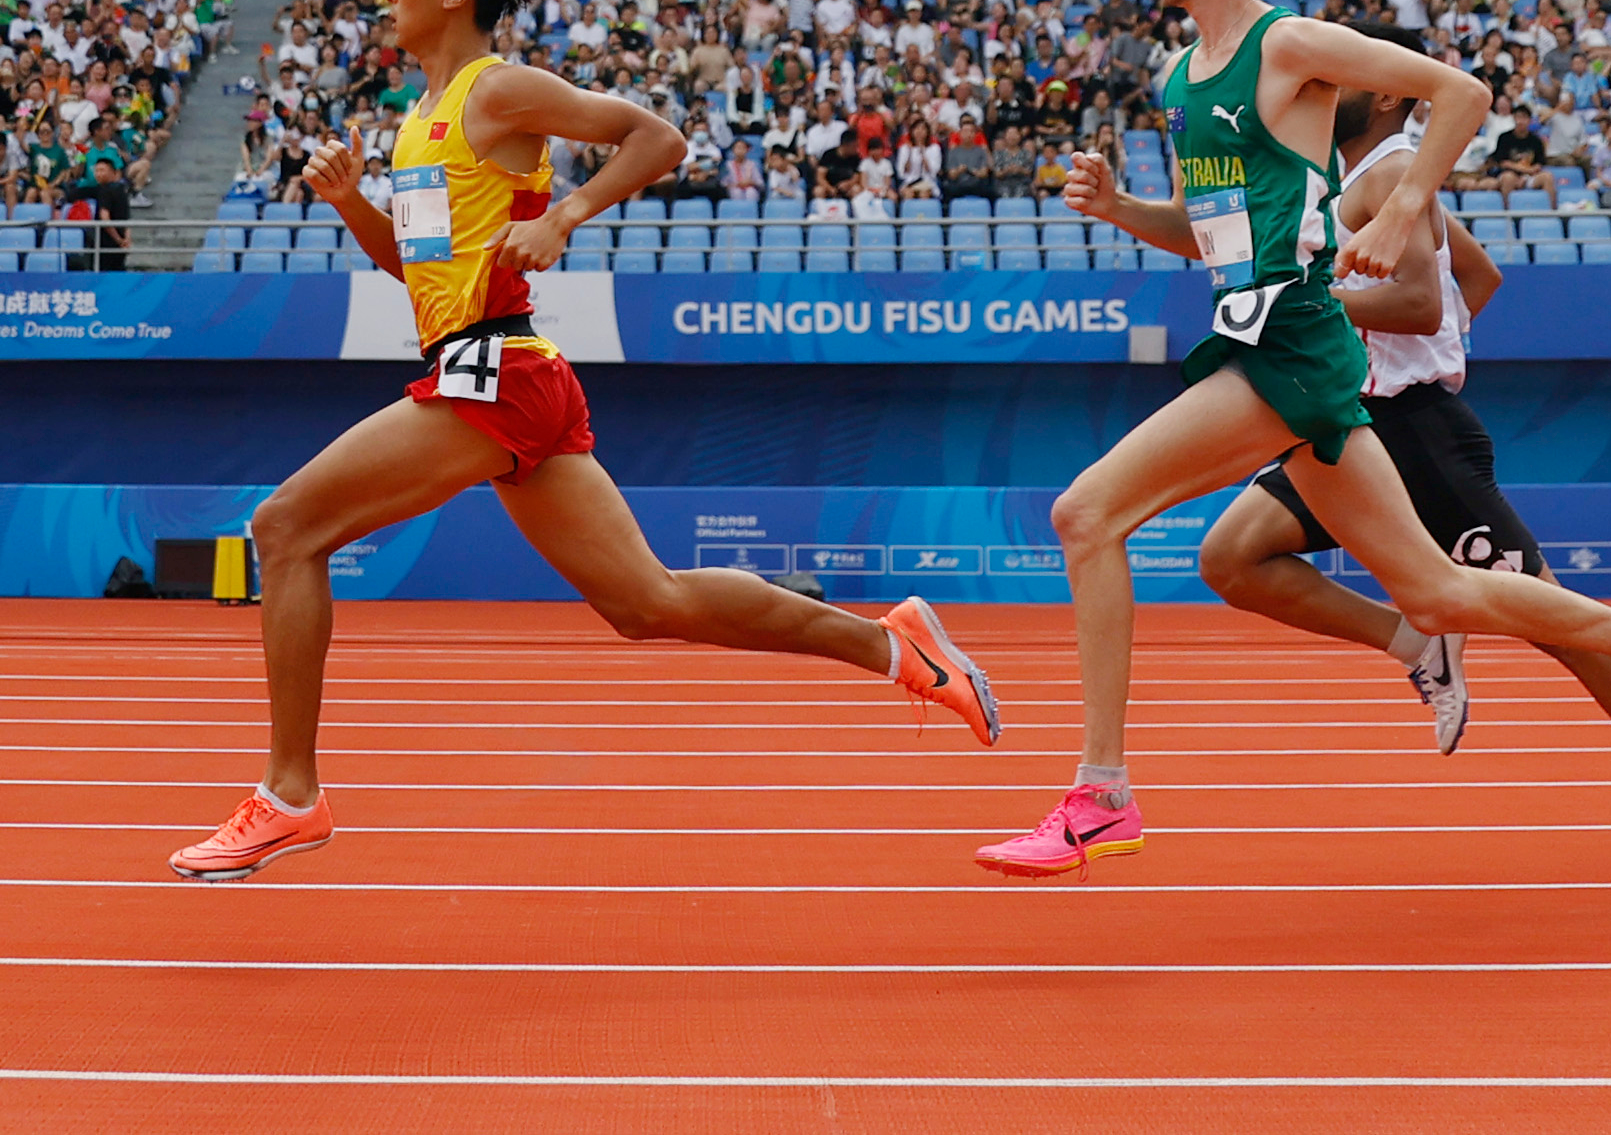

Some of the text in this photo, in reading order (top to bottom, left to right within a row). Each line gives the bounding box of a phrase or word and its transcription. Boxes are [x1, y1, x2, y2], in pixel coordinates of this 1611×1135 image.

[1181, 156, 1247, 188] STRALIA
[431, 226, 446, 236] 1120
[23, 321, 85, 339] Dreams
[88, 321, 135, 339] Come
[138, 322, 172, 340] True
[673, 299, 1128, 334] CHENGDU FISU GAMES
[444, 336, 498, 393] 4
